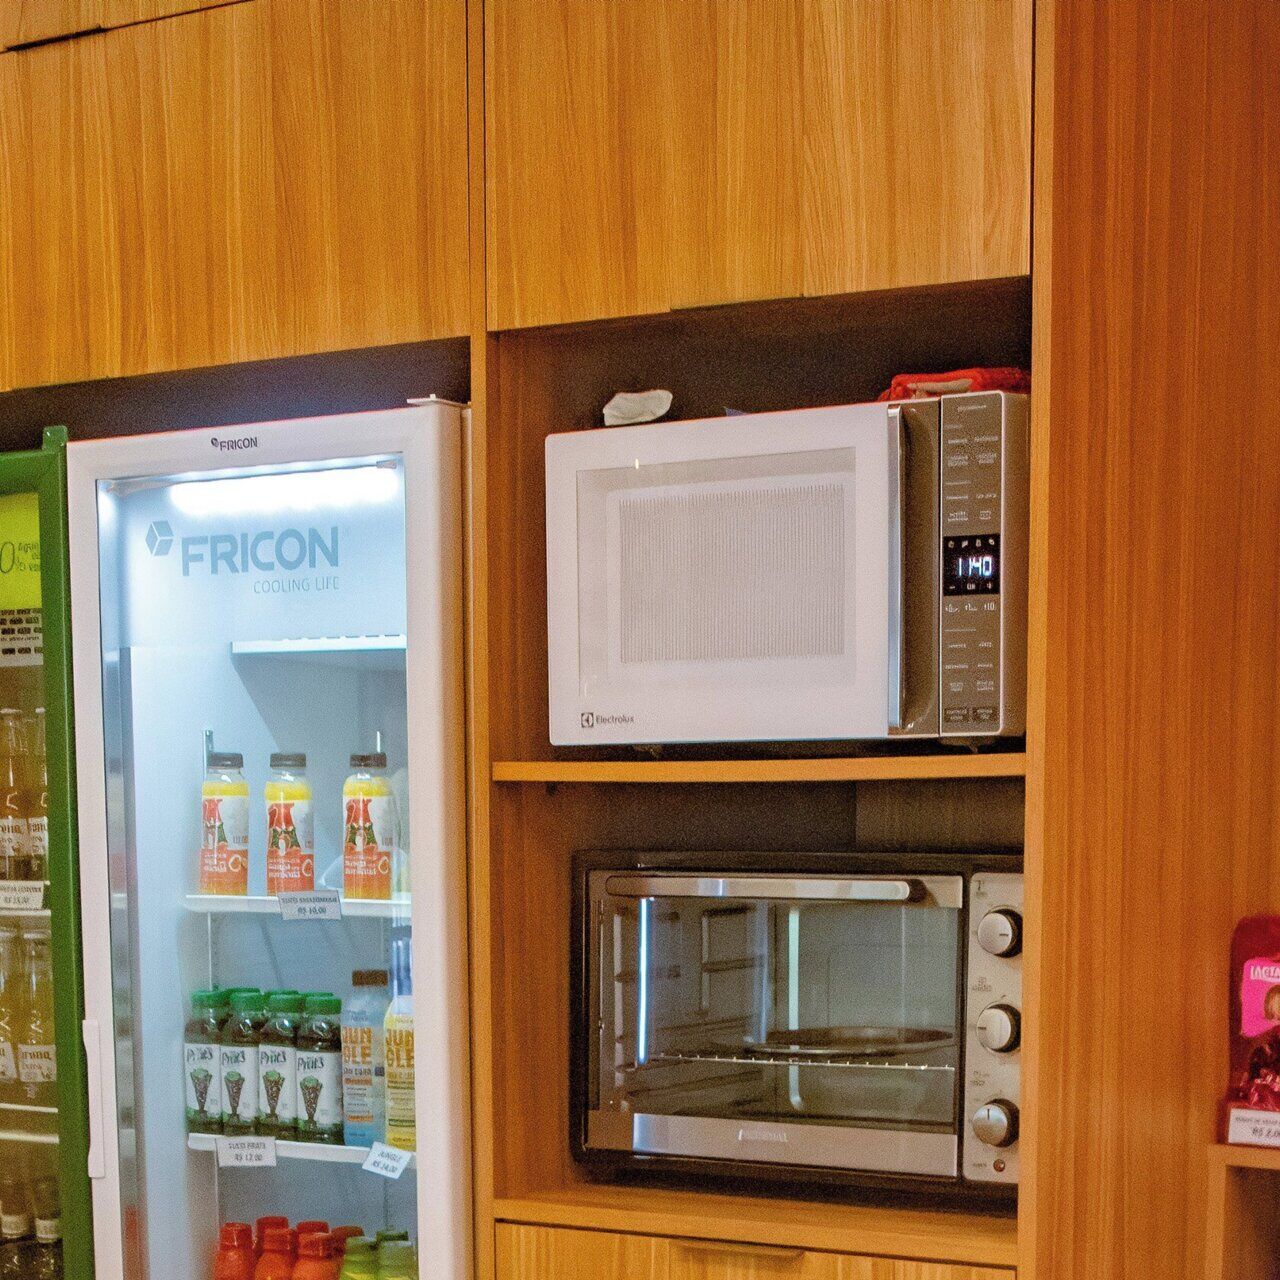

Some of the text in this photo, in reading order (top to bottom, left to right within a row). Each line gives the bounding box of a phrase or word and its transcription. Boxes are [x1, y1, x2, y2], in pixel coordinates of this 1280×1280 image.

[220, 436, 258, 451] FRICON
[181, 526, 339, 577] FRICON
[253, 576, 340, 594] COOLING LIFE
[595, 714, 635, 725] Electrolux
